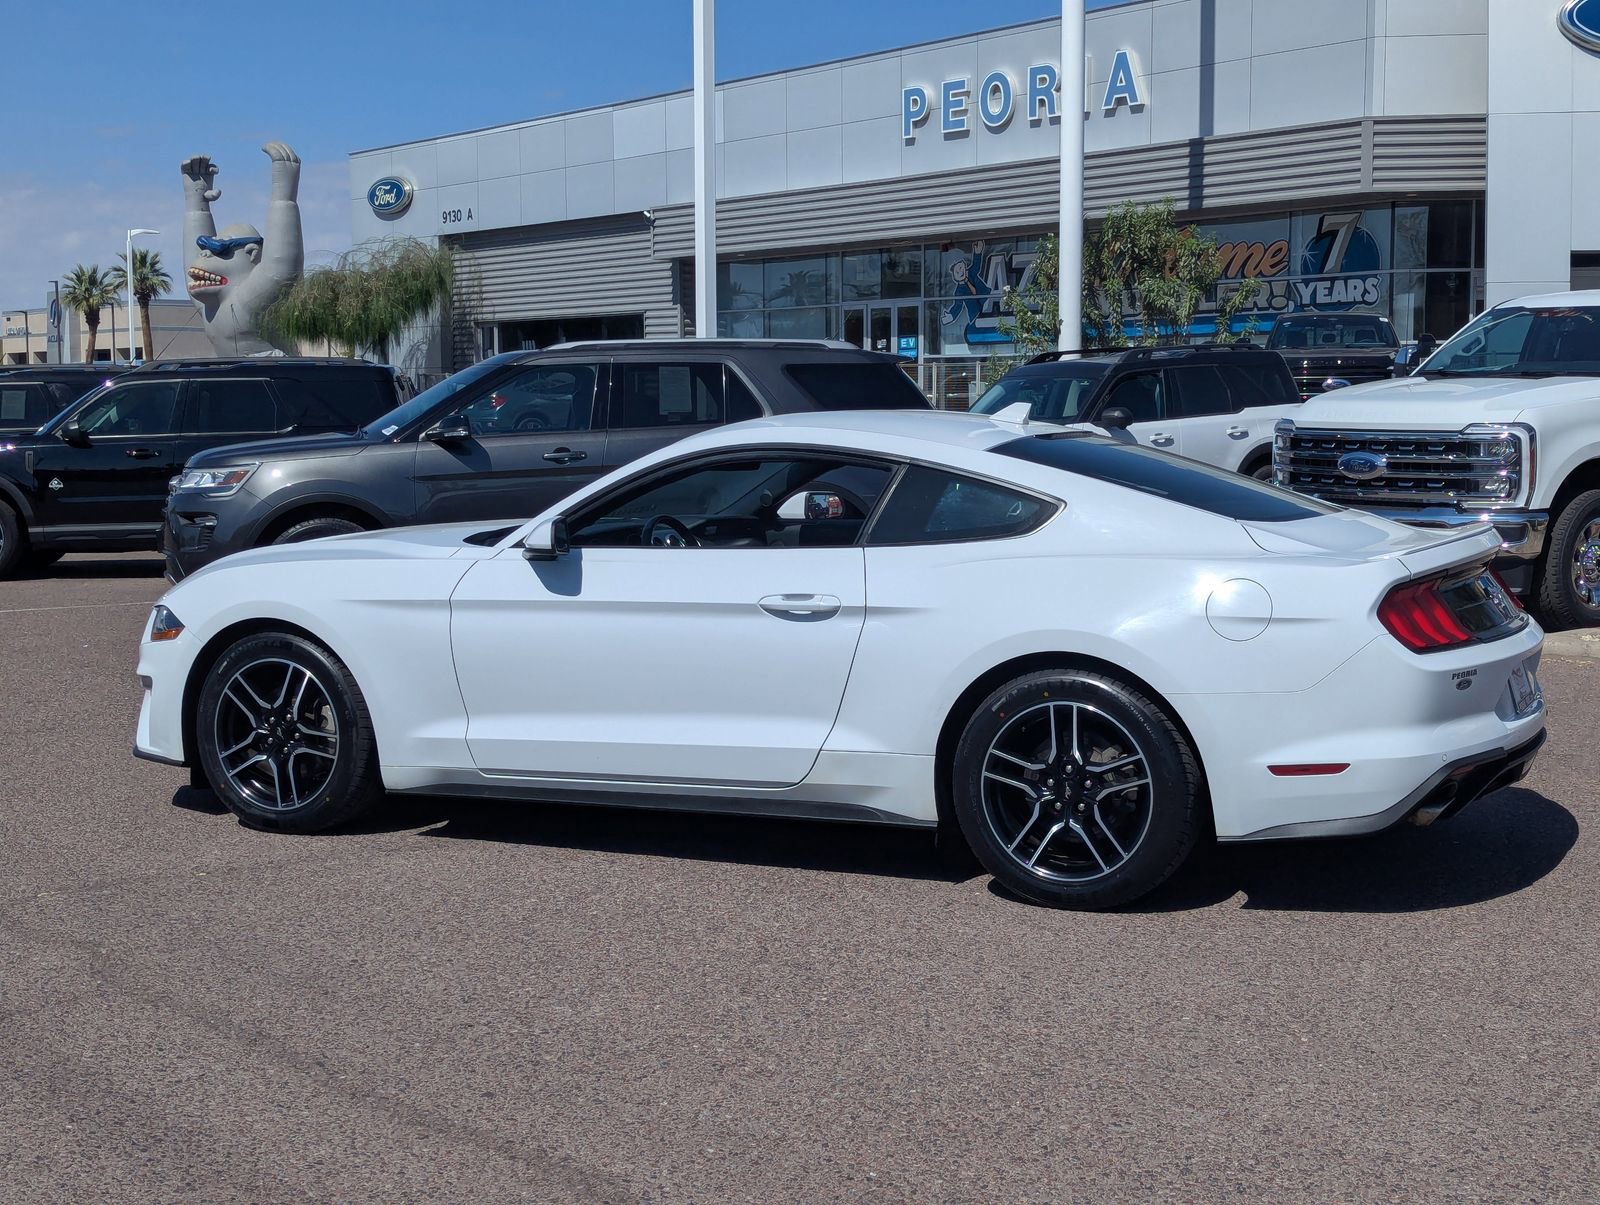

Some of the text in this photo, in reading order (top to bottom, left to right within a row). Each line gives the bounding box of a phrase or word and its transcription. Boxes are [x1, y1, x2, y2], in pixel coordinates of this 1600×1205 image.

[902, 50, 1140, 138] PEORA
[374, 185, 397, 206] Ford
[442, 208, 473, 224] 9130 A
[1319, 213, 1362, 273] 7
[1296, 278, 1379, 304] YEARS
[1452, 669, 1477, 680] PEORIA
